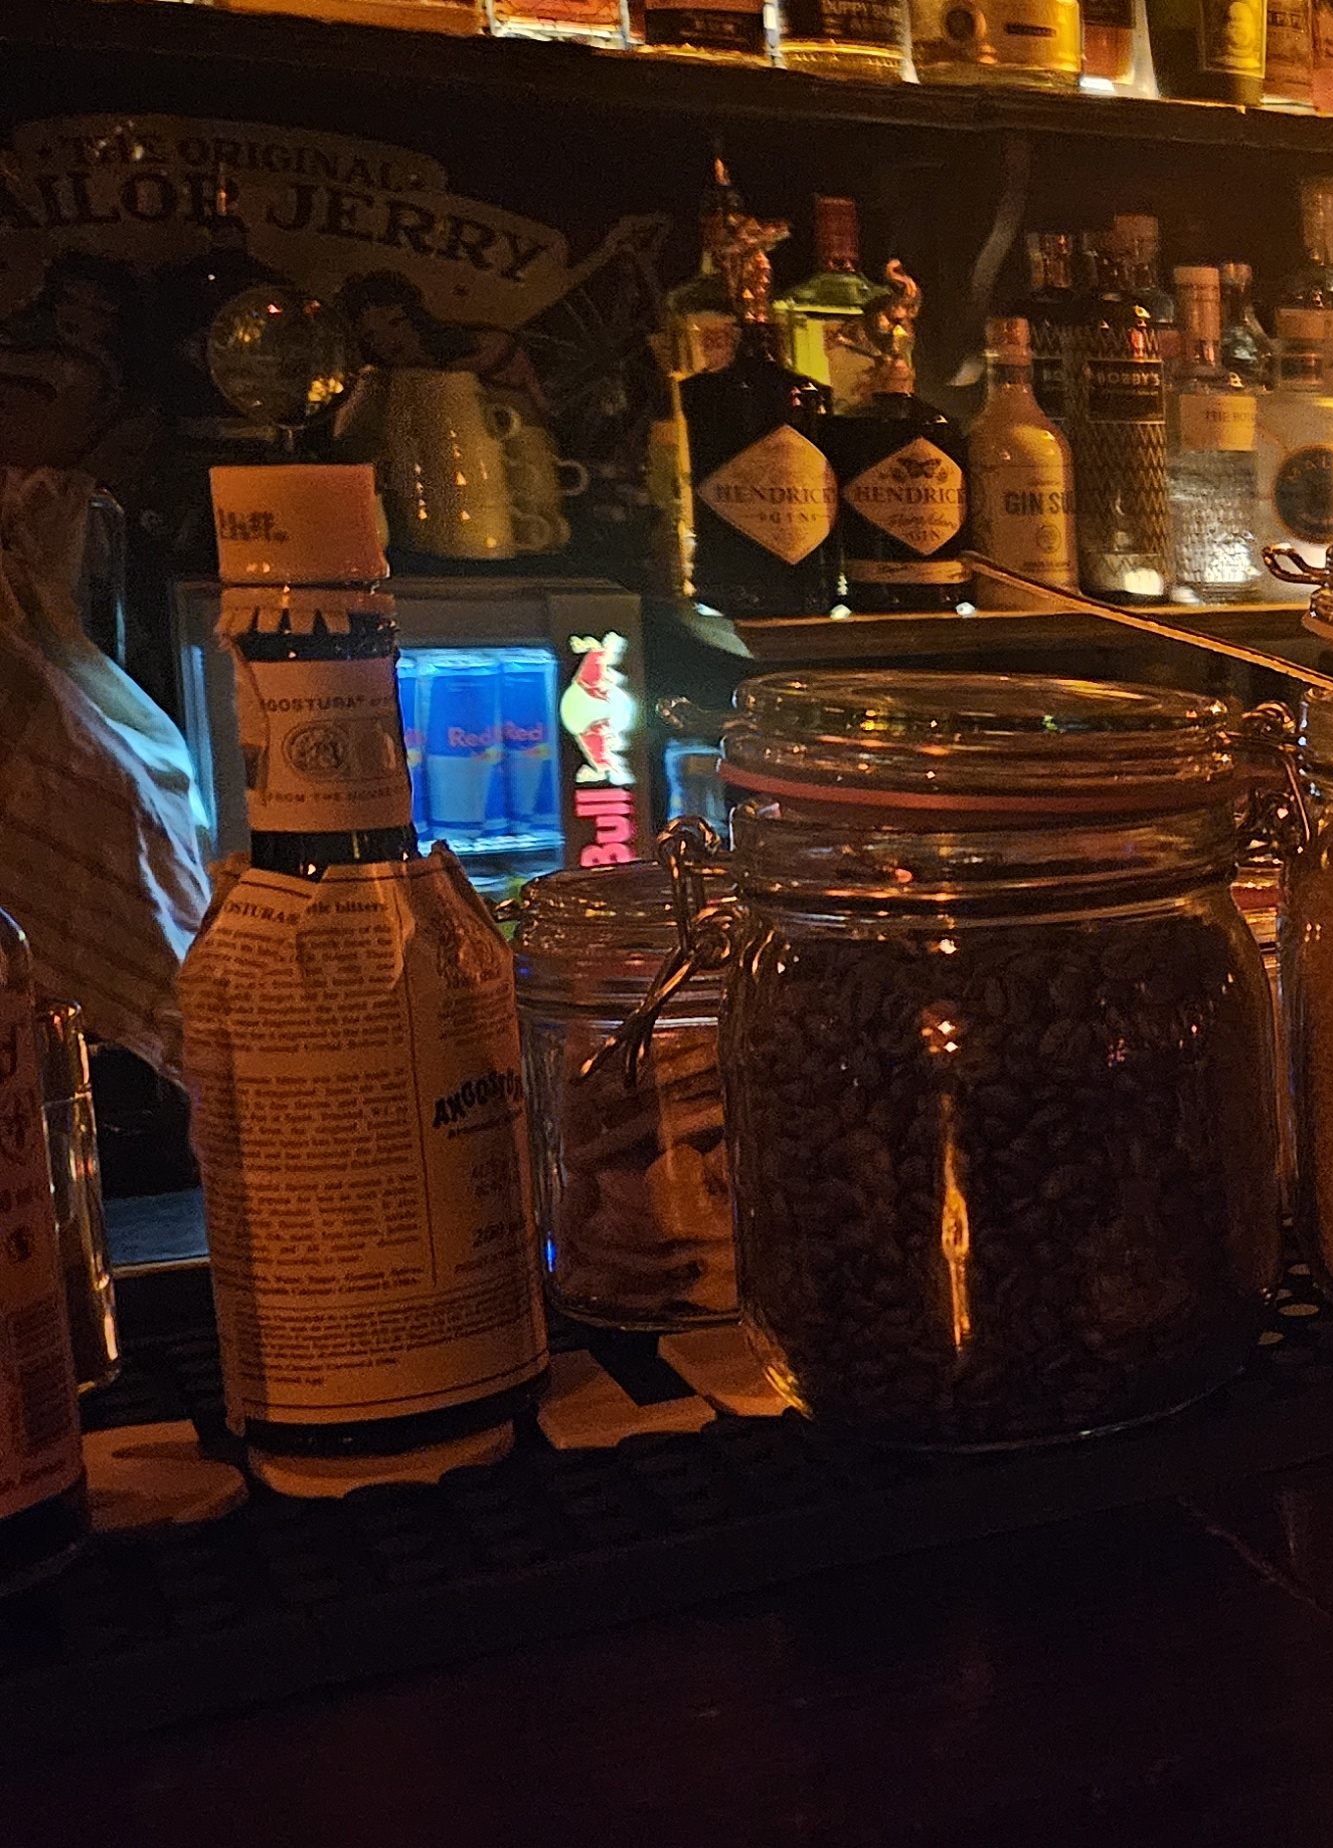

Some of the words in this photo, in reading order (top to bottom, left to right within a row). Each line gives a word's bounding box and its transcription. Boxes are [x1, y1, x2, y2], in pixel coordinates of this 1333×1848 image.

[177, 137, 399, 192] ORIGINAL
[266, 181, 552, 283] JERRY
[1005, 492, 1043, 516] GIN
[448, 725, 496, 748] Red
[575, 787, 635, 868] Bull
